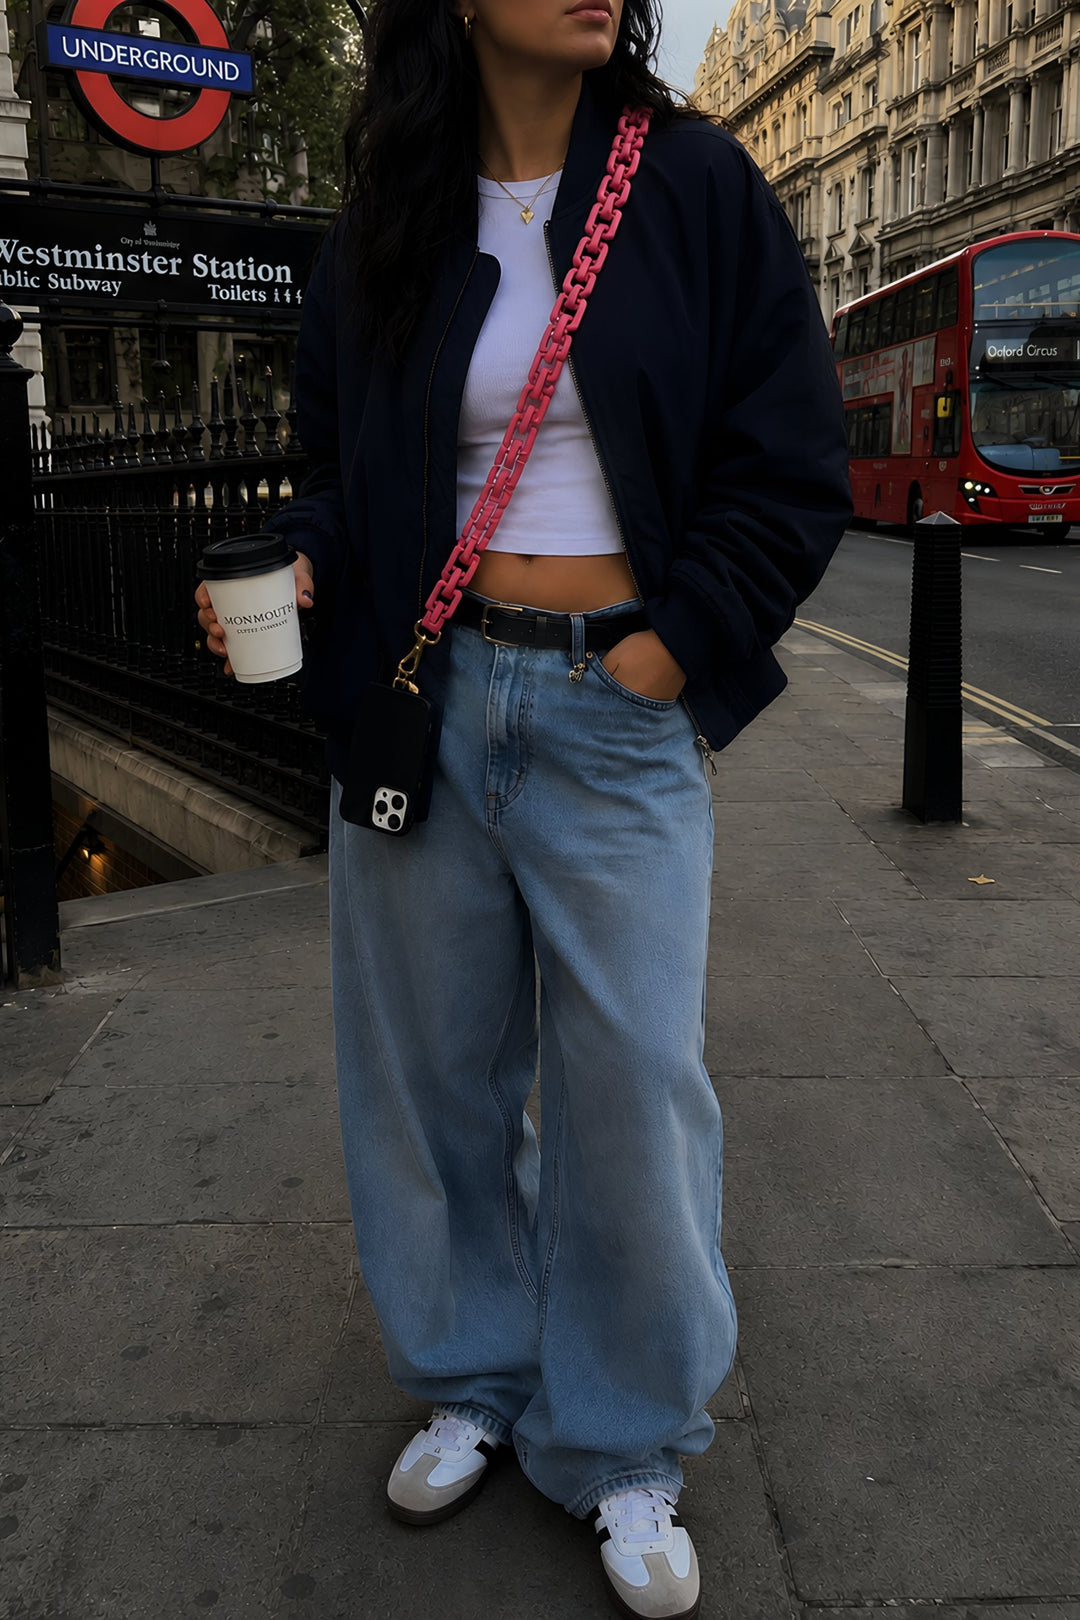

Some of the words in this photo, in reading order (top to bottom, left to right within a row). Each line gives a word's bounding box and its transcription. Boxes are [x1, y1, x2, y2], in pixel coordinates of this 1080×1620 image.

[62, 36, 240, 81] UNDERGROUND
[0, 238, 182, 276] Westminster
[192, 253, 293, 284] Station
[0, 269, 40, 289] blic
[48, 272, 122, 297] Subway
[207, 283, 267, 303] Toilets
[224, 601, 295, 626] MONMOUTH
